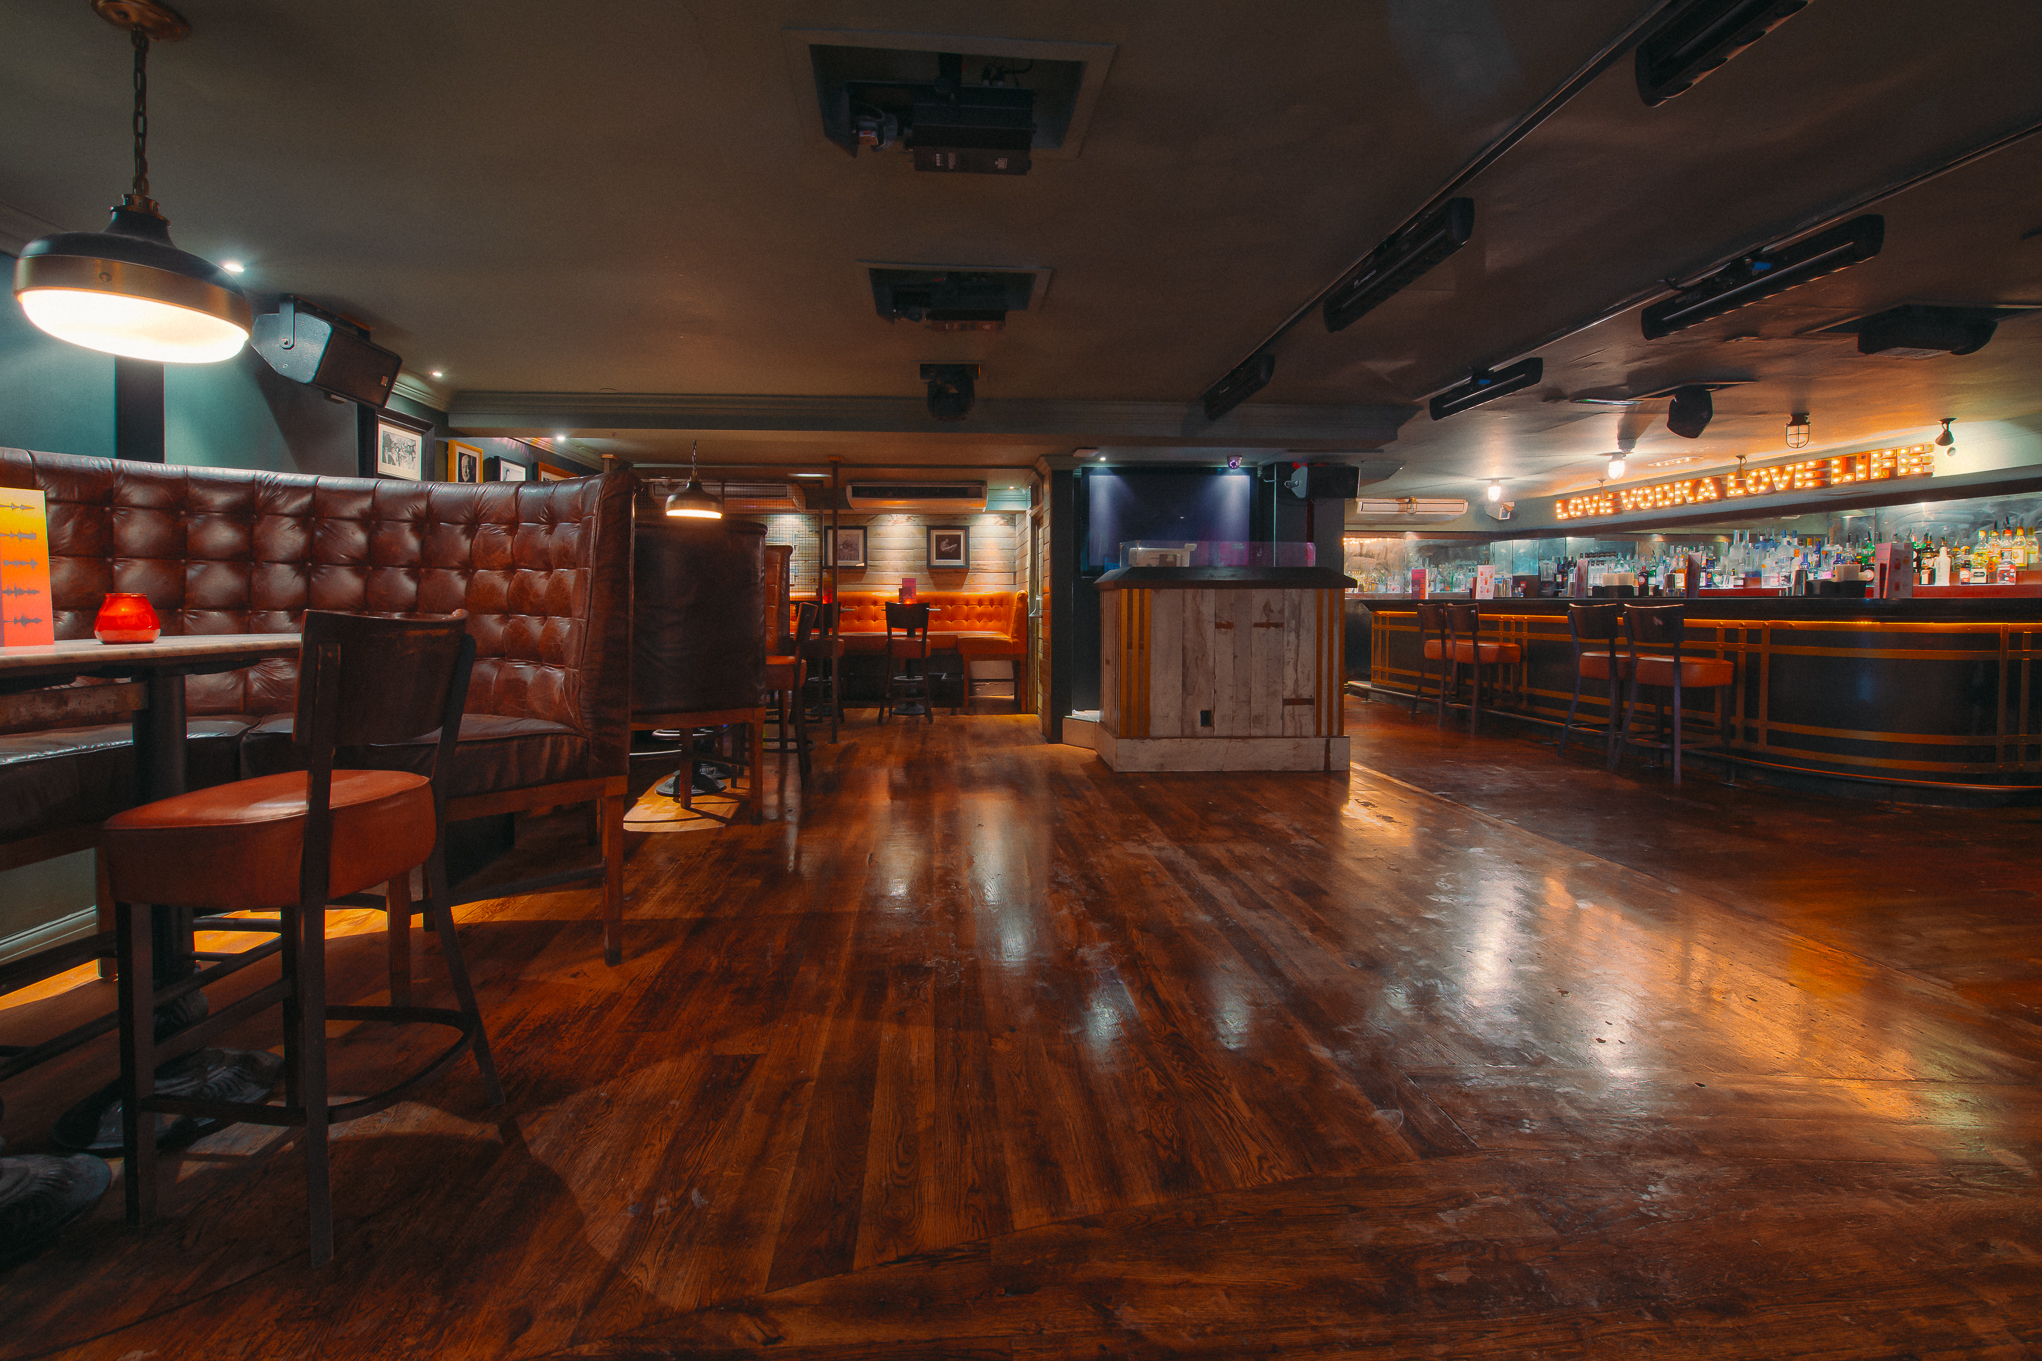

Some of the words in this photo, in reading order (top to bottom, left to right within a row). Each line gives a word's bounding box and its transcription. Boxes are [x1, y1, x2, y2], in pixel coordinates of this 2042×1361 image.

[1556, 493, 1620, 520] LOVE
[1620, 477, 1721, 511] VODKA
[1727, 460, 1825, 497] LOVE
[1831, 443, 1935, 484] LIFE
